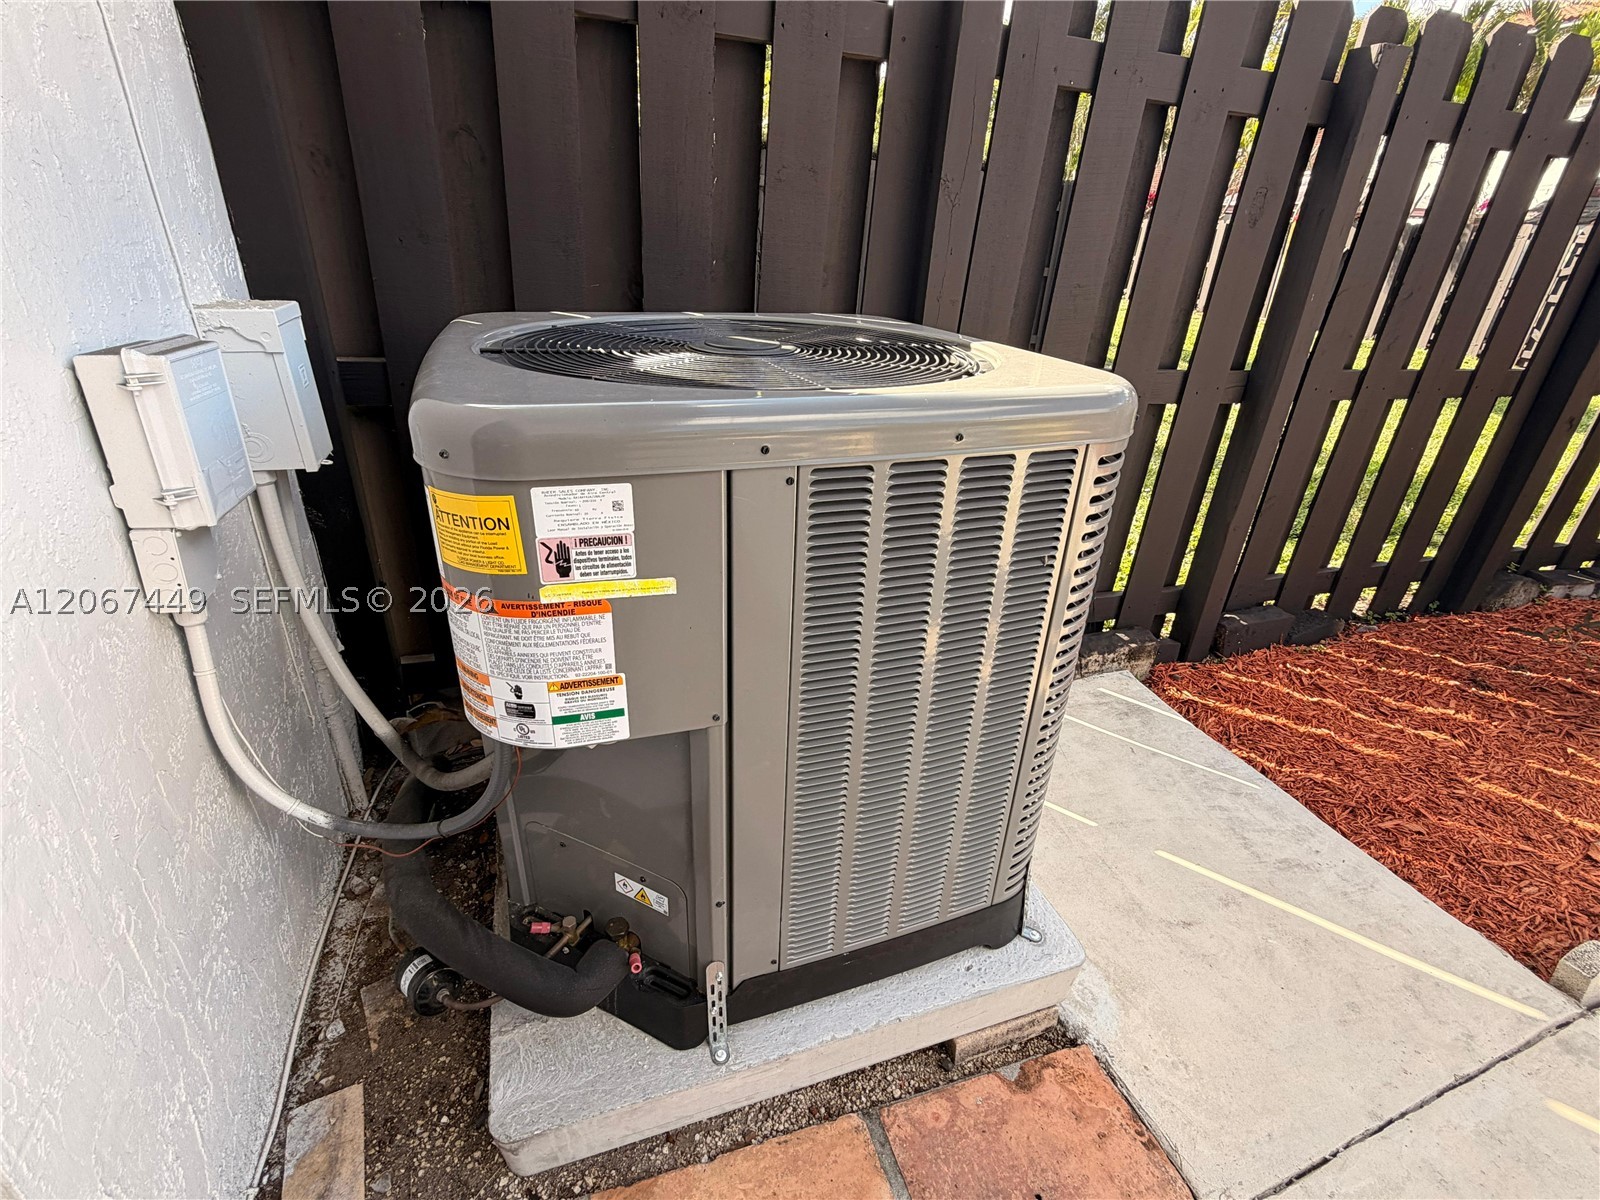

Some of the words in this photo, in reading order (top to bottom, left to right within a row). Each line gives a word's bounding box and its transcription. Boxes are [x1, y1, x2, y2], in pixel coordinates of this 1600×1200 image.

[436, 508, 510, 530] ATTENTION
[579, 536, 624, 548] PRECAUCION
[501, 602, 565, 610] AVERTISSEMENT
[530, 608, 576, 618] D'INCENDIE
[572, 648, 602, 656] CONSTITUER
[560, 676, 619, 690] ADVERTISSEMENT
[580, 687, 615, 695] DANGEREUSE
[580, 712, 596, 720] AVIS
